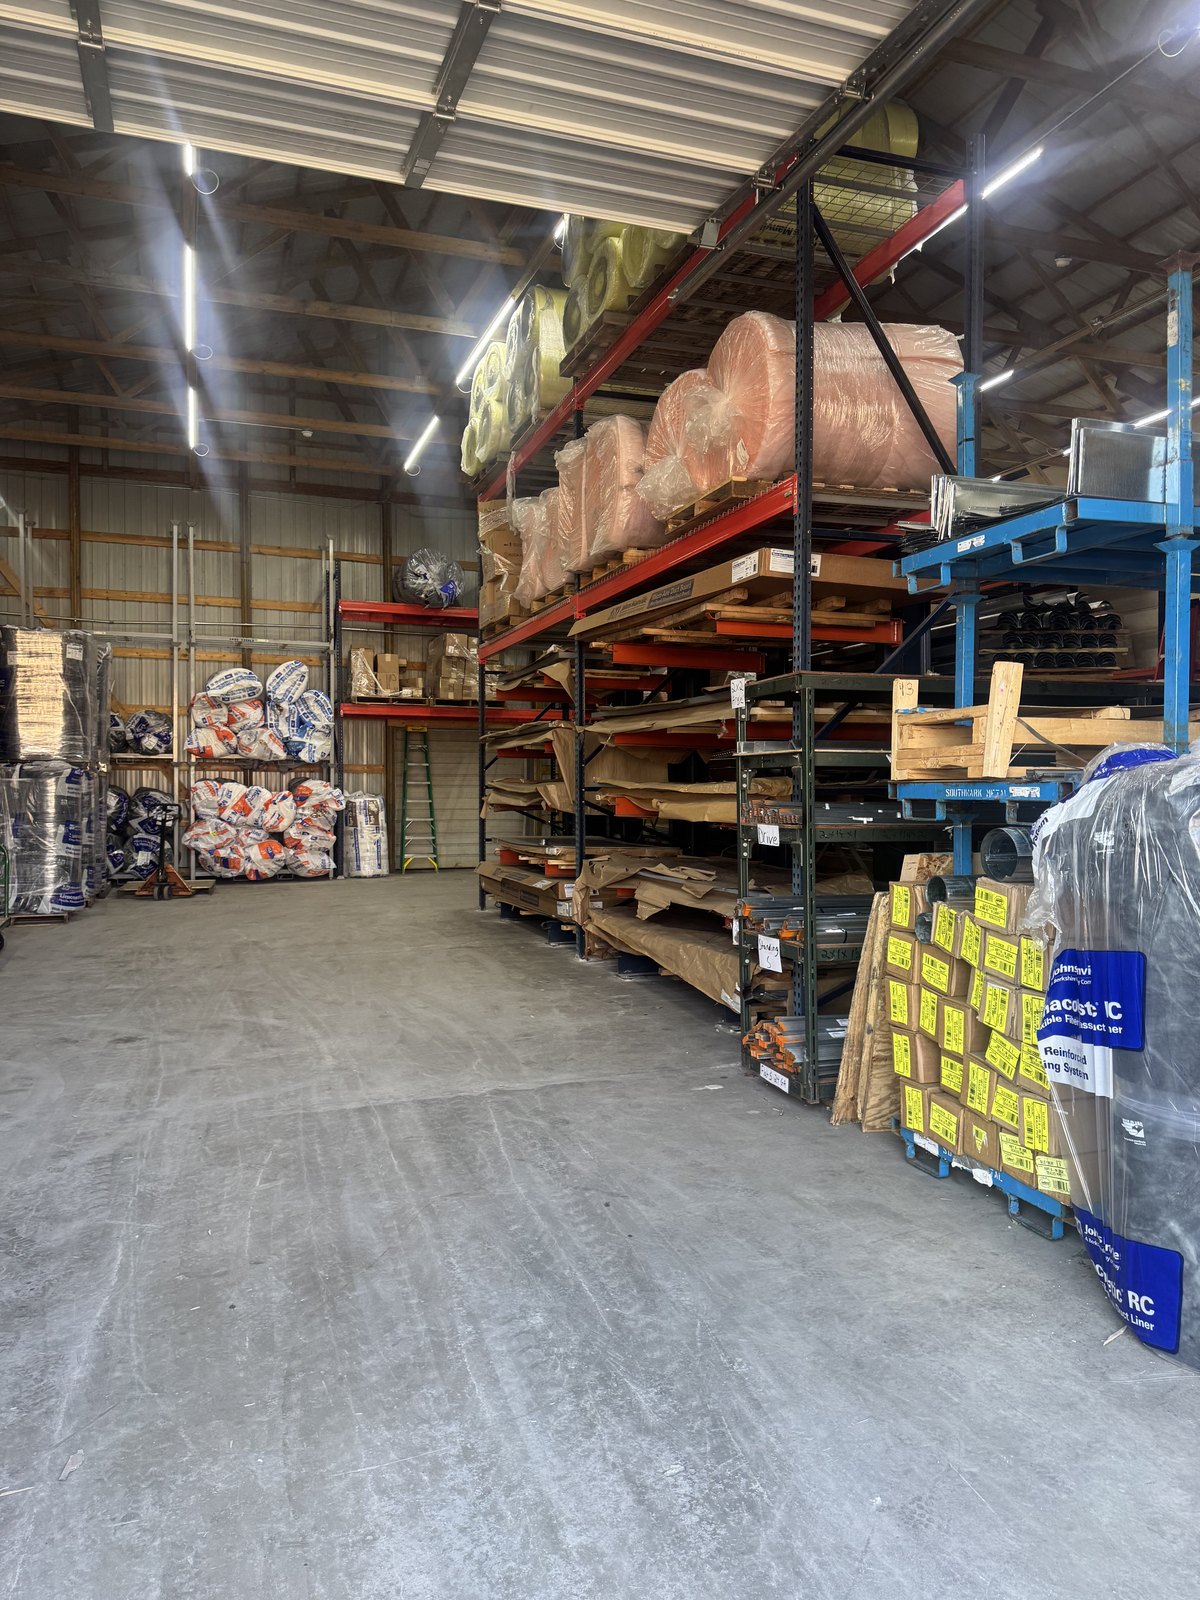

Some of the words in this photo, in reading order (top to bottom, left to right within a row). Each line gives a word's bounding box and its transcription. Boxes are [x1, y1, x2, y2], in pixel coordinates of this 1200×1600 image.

[757, 826, 779, 846] Drive
[1127, 1290, 1155, 1316] RC
[1130, 1315, 1155, 1332] Liner
